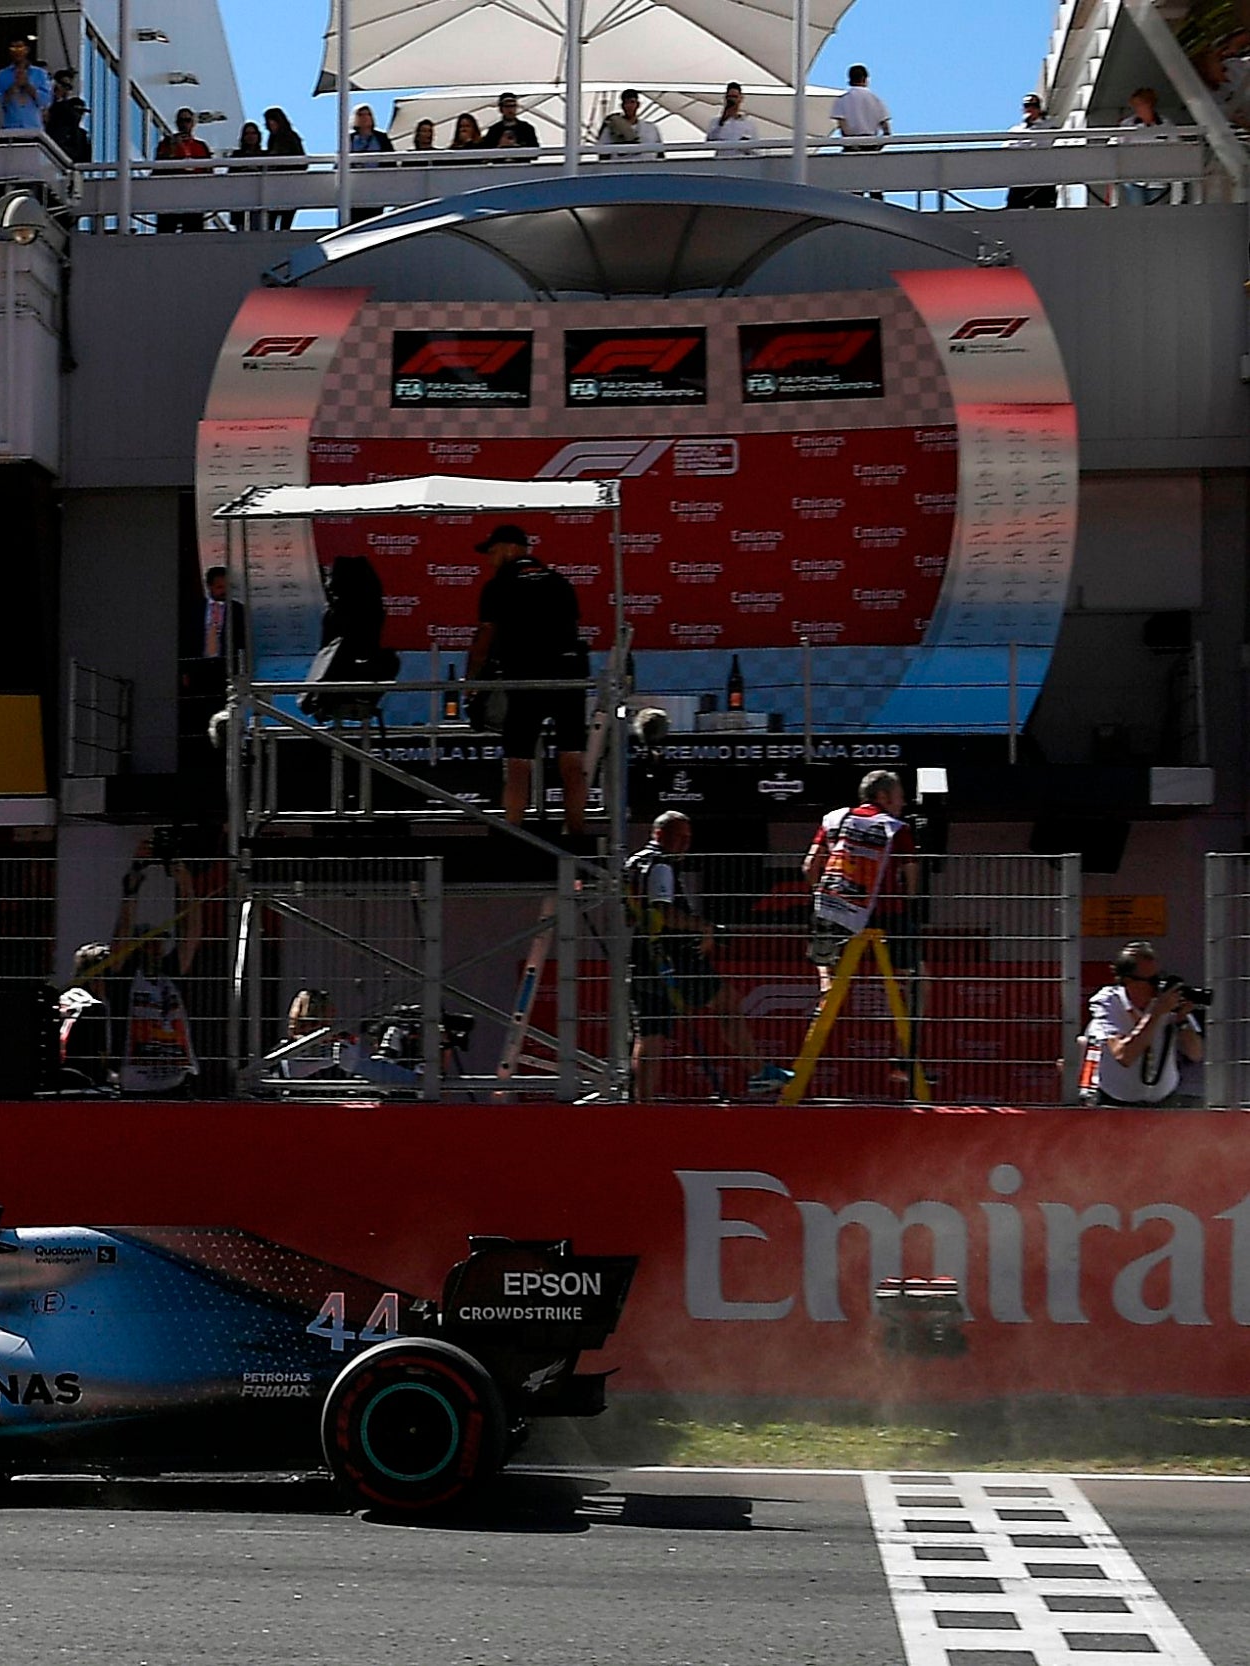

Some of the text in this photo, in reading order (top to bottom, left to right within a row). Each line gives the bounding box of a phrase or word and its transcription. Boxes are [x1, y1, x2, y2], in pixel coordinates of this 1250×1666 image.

[34, 1245, 93, 1257] Qualcomm
[503, 1271, 601, 1297] EPSON
[459, 1306, 582, 1321] CROWDSTRIKE
[306, 1292, 407, 1352] 44
[242, 1372, 313, 1383] PETRONAS
